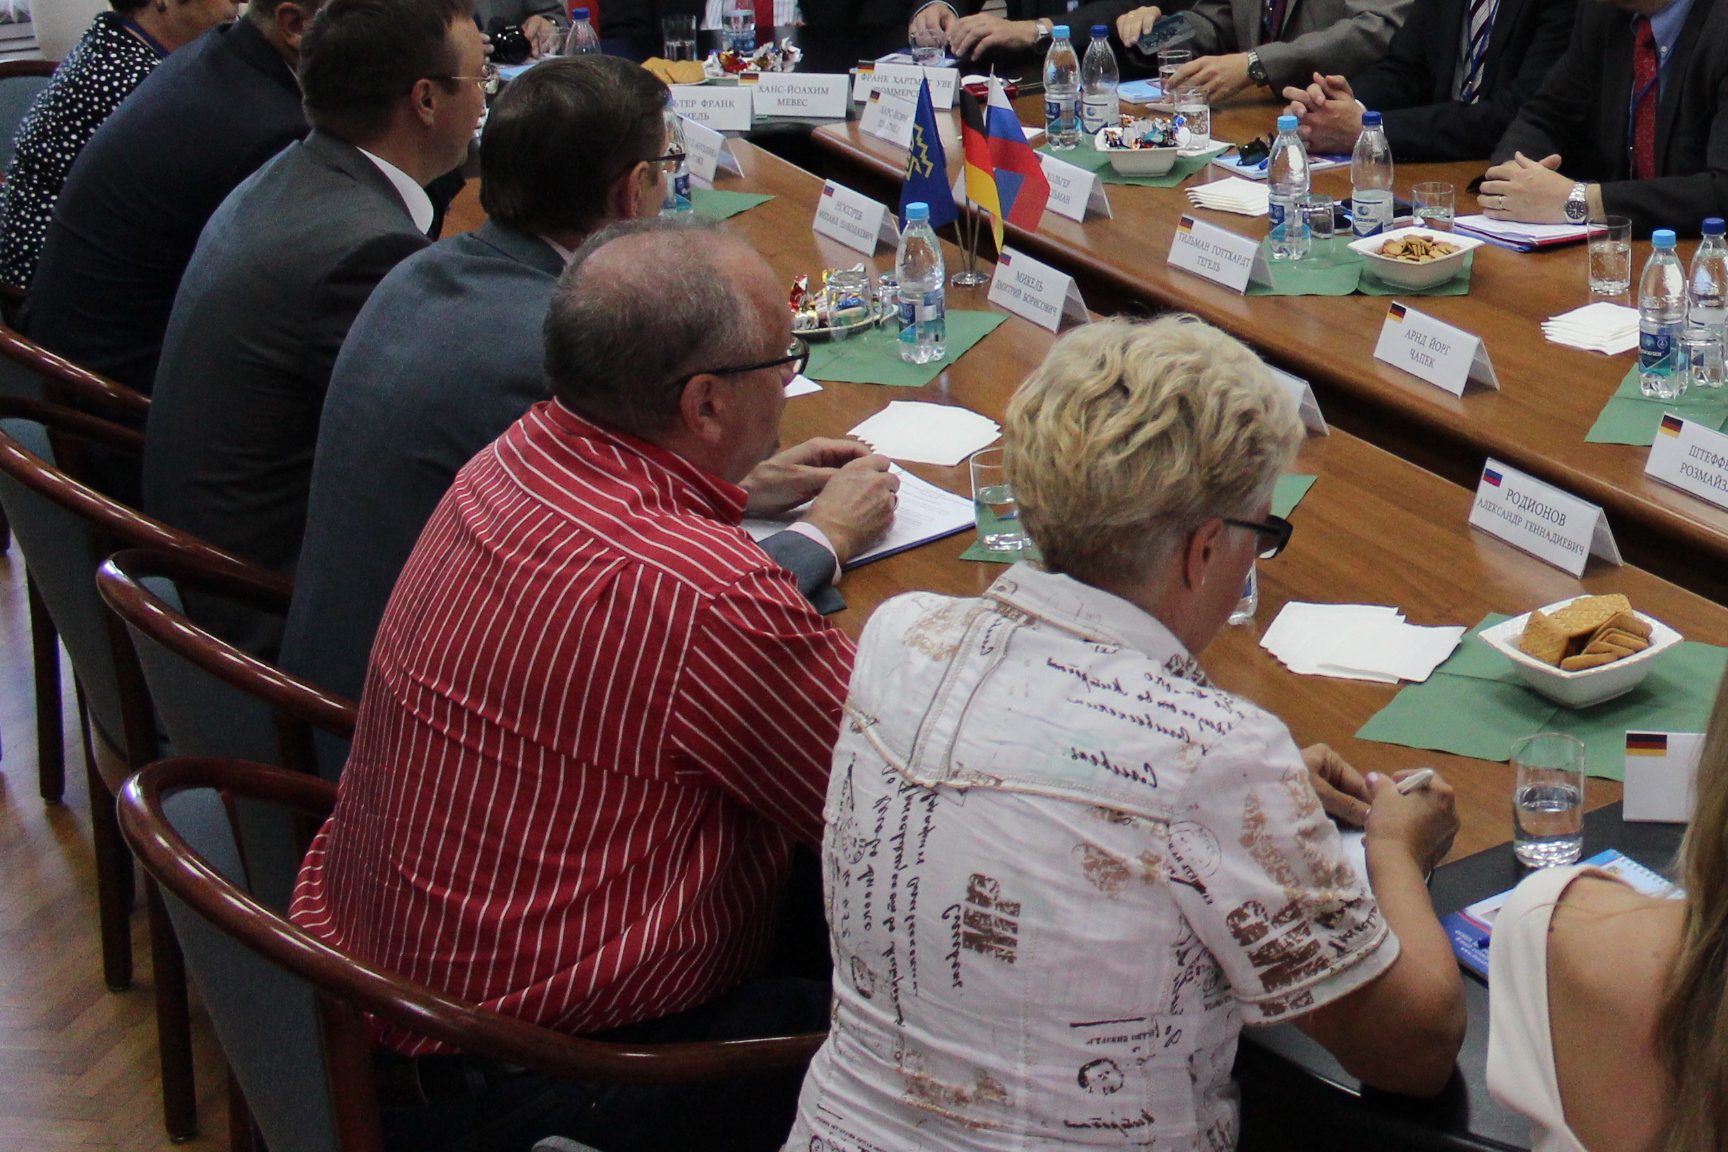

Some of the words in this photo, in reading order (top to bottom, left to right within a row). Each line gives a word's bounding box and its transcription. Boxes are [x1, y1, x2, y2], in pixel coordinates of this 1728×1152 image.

[757, 85, 829, 97] ХАНС-ЙОАХИМ
[893, 76, 933, 87] ХАРТМТ
[937, 80, 953, 89] УВЕ
[701, 99, 735, 108] ФРАНК
[777, 98, 808, 108] МЕВЕС
[1179, 232, 1210, 252] ТИЛЬМАН
[1197, 255, 1221, 272] ТЕГЕЛЬ
[1016, 271, 1043, 292] МИКЕЛЬ
[1022, 292, 1057, 316] БОРИСОВИЧ
[1404, 329, 1427, 348] АРНД
[1428, 337, 1451, 356] ЙОРГ
[1410, 348, 1436, 369] ЧАПЕК
[1505, 488, 1567, 527] РОДИОНОВ
[1477, 498, 1523, 526] АЛЕКСАНДР
[1524, 520, 1585, 556] ГЕННАДИЕВИЧ
